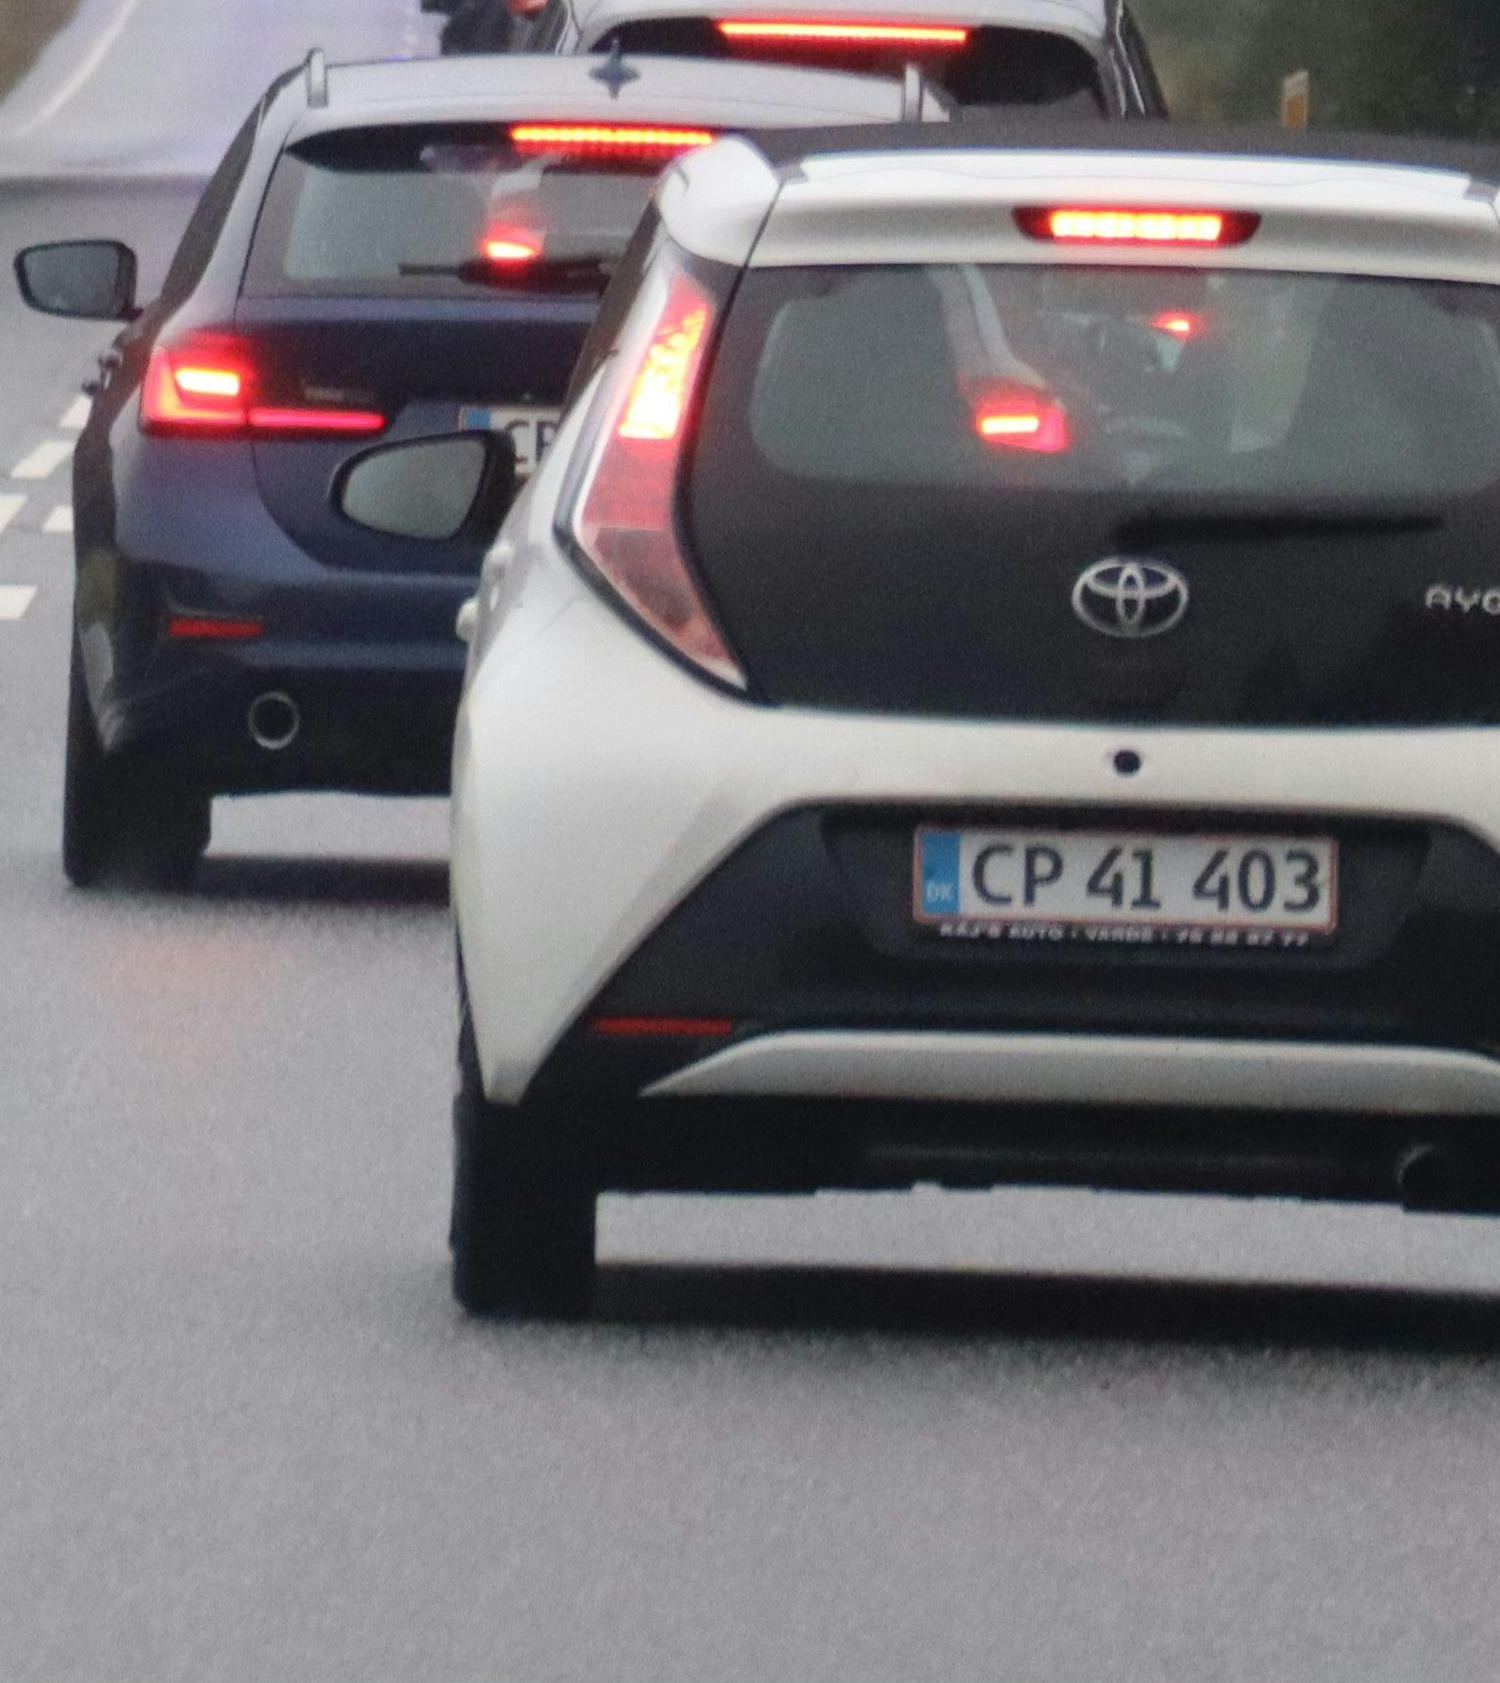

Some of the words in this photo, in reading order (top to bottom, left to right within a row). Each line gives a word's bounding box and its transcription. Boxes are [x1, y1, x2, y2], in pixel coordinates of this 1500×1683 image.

[971, 845, 1065, 906] CP
[1085, 847, 1162, 911] 41
[1192, 848, 1321, 913] 403
